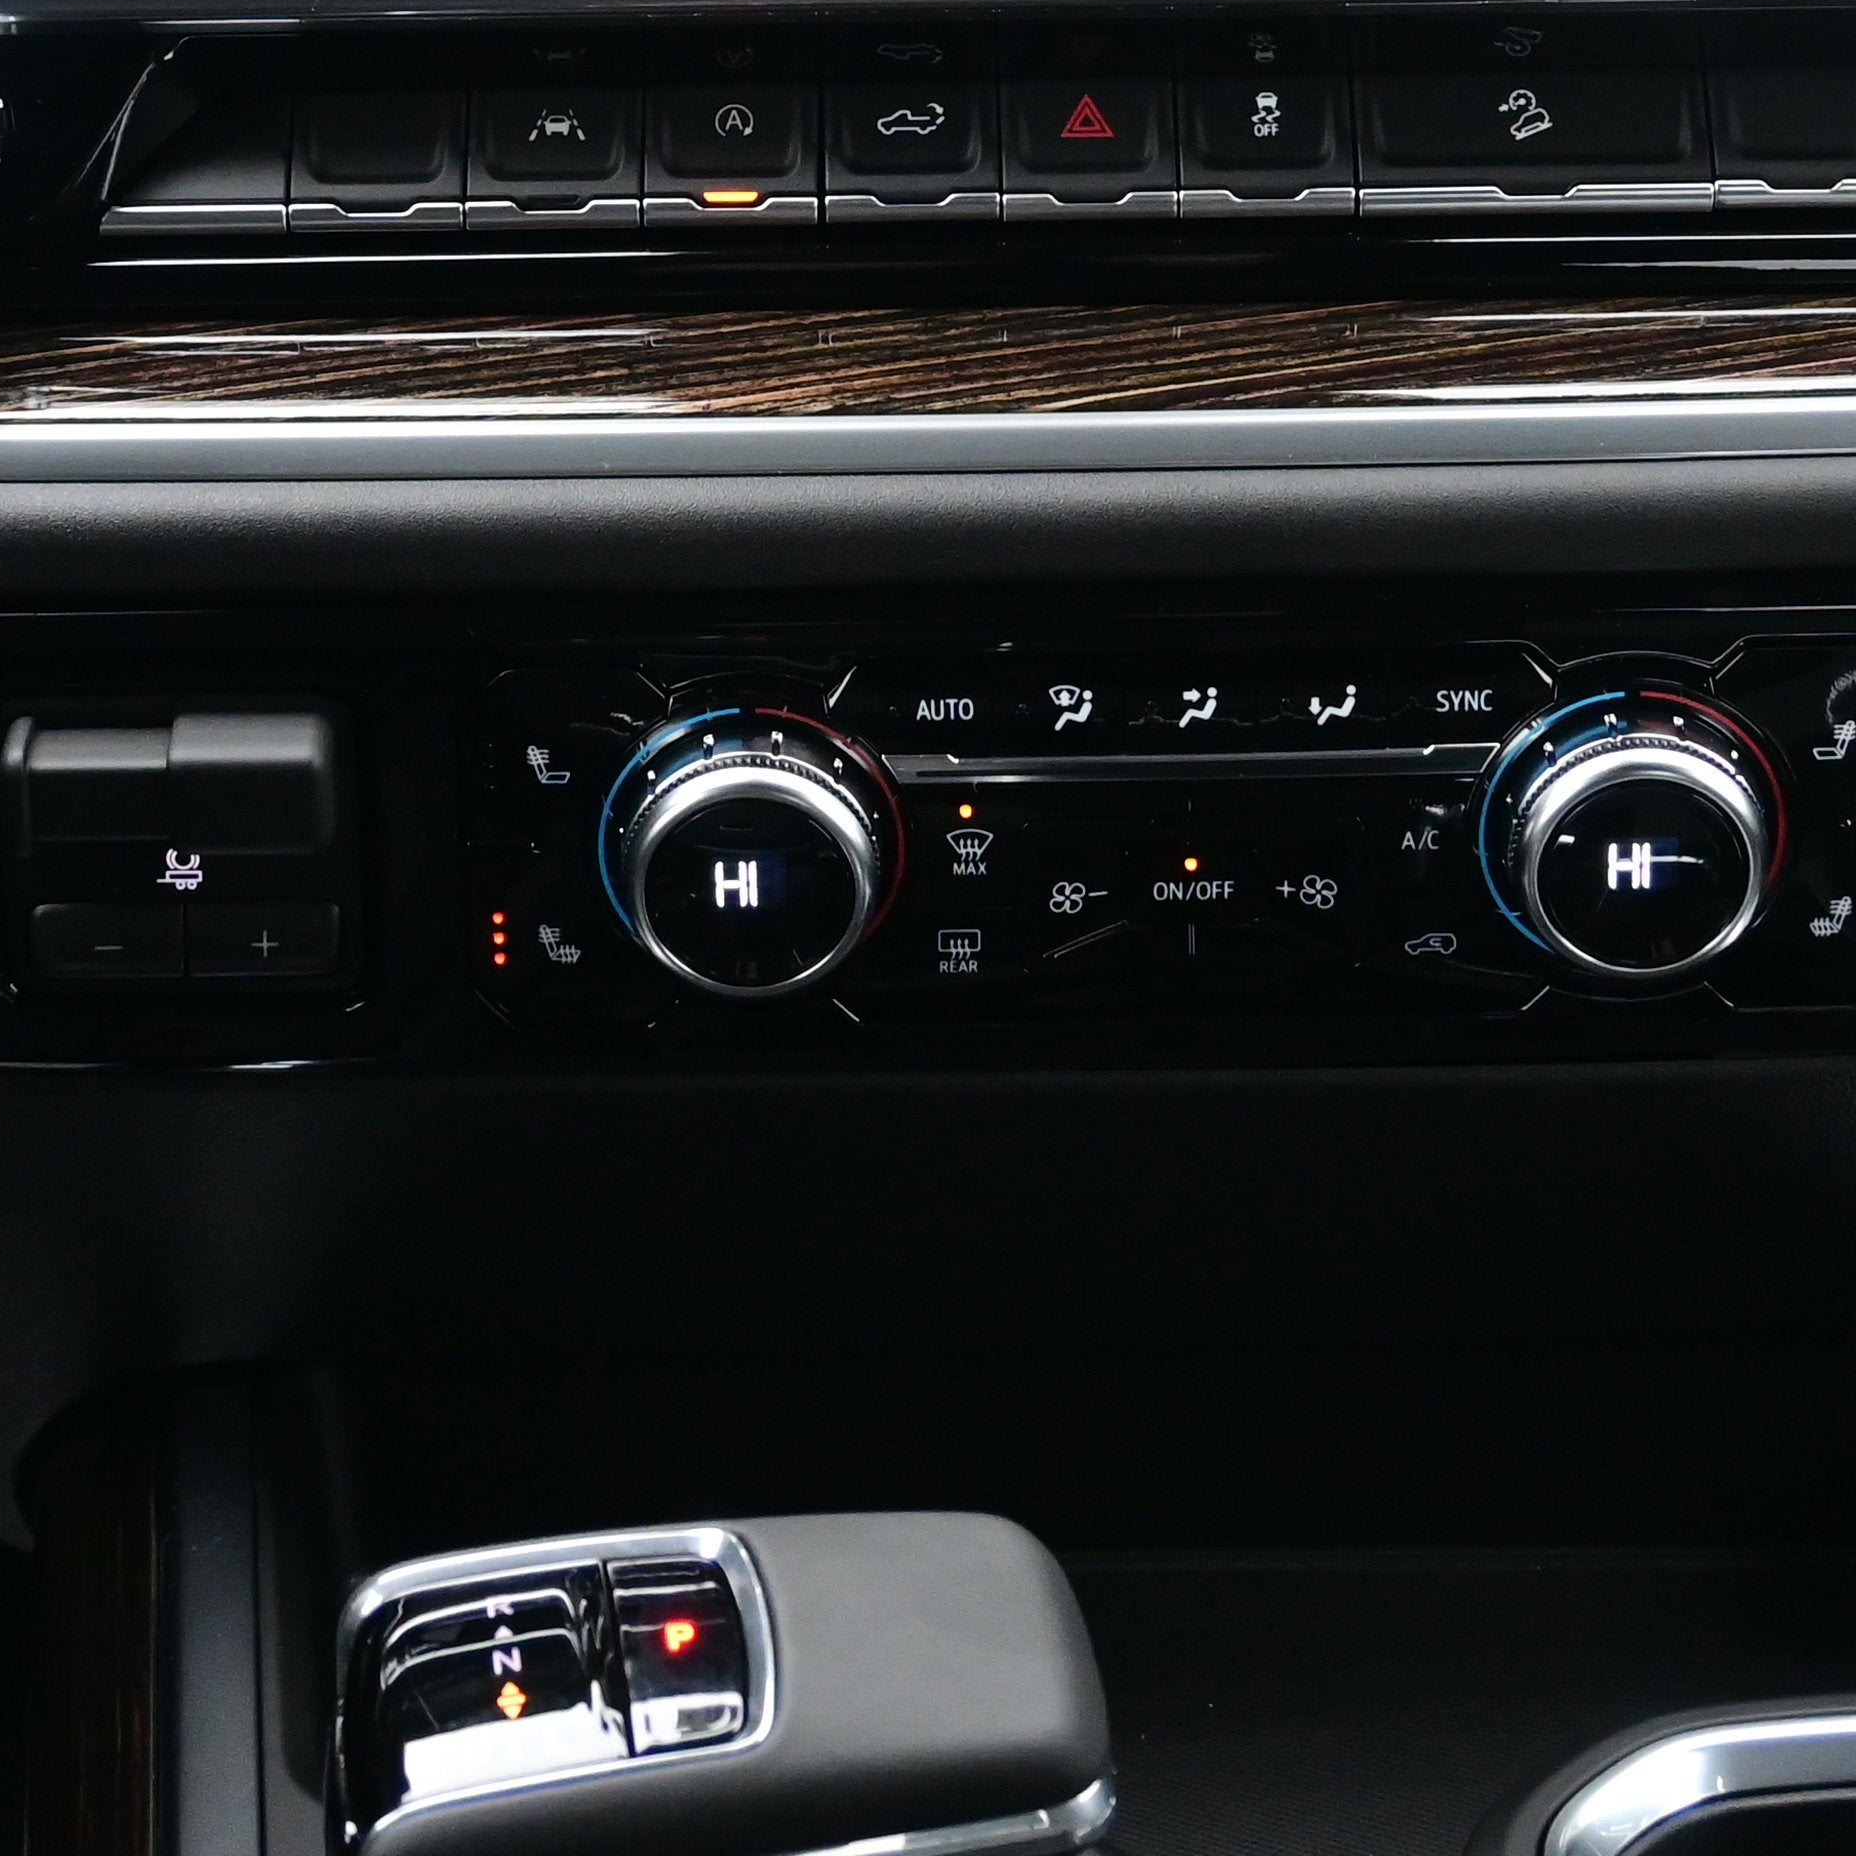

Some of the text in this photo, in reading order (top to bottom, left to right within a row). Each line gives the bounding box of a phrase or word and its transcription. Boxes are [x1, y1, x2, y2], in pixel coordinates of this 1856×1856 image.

[1253, 123, 1280, 137] OFF
[916, 698, 974, 721] AUTO
[1436, 689, 1493, 712] SYNC
[1401, 830, 1439, 850] A/C
[953, 862, 987, 875] MAX
[1607, 842, 1652, 890] HI
[714, 859, 758, 909] HI
[1153, 880, 1234, 901] ON/OFF
[939, 959, 978, 973] REAR
[663, 1620, 696, 1653] P
[491, 1645, 523, 1676] N
